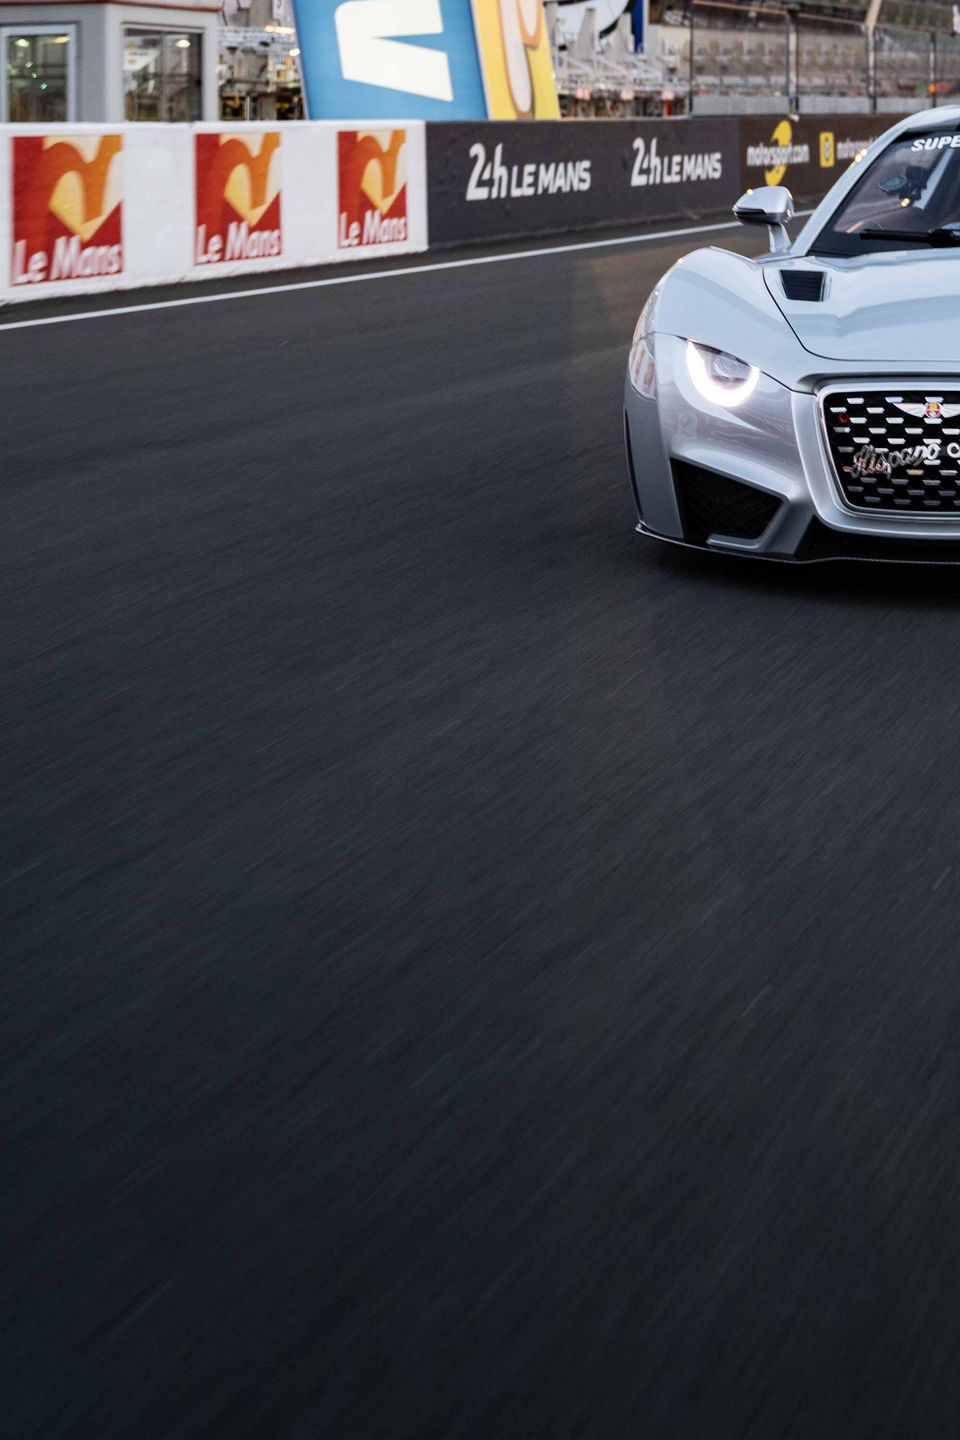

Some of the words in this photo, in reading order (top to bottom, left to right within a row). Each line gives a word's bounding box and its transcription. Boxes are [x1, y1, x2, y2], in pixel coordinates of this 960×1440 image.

[466, 142, 509, 201] 24h
[510, 164, 536, 197] LE
[538, 160, 592, 195] MANS
[663, 156, 681, 184] LE
[683, 152, 722, 182] MANS
[746, 141, 810, 171] motorsport.com
[197, 224, 223, 263] Le
[225, 220, 281, 260] Mans
[340, 212, 361, 247] Le
[362, 209, 407, 244] Mans
[14, 239, 49, 283] Le
[50, 235, 122, 280] Mans
